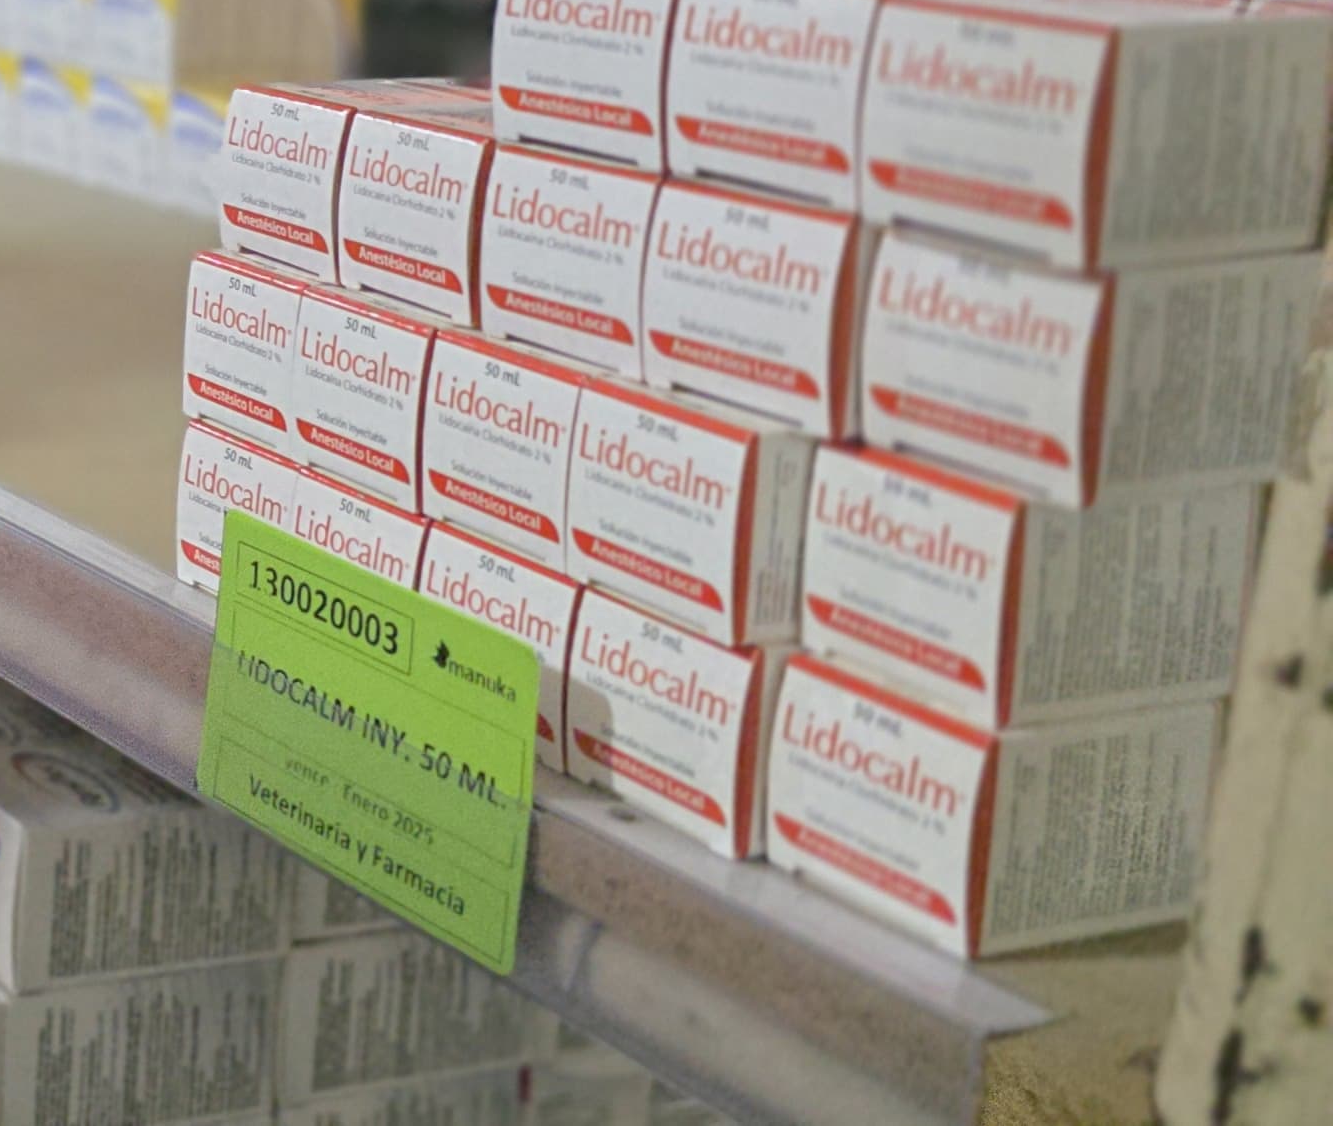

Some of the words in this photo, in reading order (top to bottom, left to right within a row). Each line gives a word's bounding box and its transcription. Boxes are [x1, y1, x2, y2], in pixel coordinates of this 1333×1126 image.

[683, 4, 853, 67] Lidocalm
[877, 41, 1077, 114] Lidocalm
[271, 103, 283, 116] 50
[284, 107, 300, 121] mL
[519, 92, 590, 120] Anestésico
[593, 104, 633, 125] Local
[228, 117, 328, 170] Lidocalm
[396, 131, 410, 145] 50
[411, 135, 429, 151] mL
[349, 146, 463, 204] Lidocalm
[550, 168, 567, 184] 50
[569, 174, 589, 190] mL
[237, 213, 287, 237] Anestésico
[288, 226, 314, 244] Local
[492, 183, 632, 248] Lidocalm
[359, 246, 415, 274] Anestésico
[417, 262, 446, 283] Local
[657, 220, 820, 295] Lidocalm
[229, 277, 241, 289] 50
[242, 282, 256, 297] mL
[878, 268, 1074, 357] Lidocalm
[191, 287, 287, 348] Lidocalm
[344, 317, 359, 331] 50
[360, 323, 377, 339] mL
[505, 292, 575, 323] Anestésico
[578, 311, 614, 336] Local
[301, 327, 410, 396] Lidocalm
[485, 361, 501, 379] 50
[502, 369, 521, 386] mL
[200, 382, 247, 411] Anestésico
[249, 399, 273, 421] Local
[434, 372, 559, 448] Lidocalm
[311, 428, 365, 459] Anestésico
[366, 448, 394, 472] Local
[638, 415, 655, 431] 50
[657, 423, 679, 442] mL
[224, 448, 237, 462] 50
[238, 453, 253, 470] mL
[579, 423, 727, 510] Lidocalm
[184, 455, 283, 525] Lidocalm
[339, 498, 354, 512] 50
[355, 505, 371, 522] mL
[445, 480, 508, 516] Anestésico
[509, 504, 542, 531] Local
[295, 505, 404, 582] Lidocalm
[815, 482, 991, 581] Lidocalm
[477, 555, 495, 572] 50
[496, 563, 516, 582] mL
[591, 540, 663, 582] Anestésico
[665, 569, 703, 598] Local
[249, 560, 400, 655] 130020003
[426, 560, 554, 648] Lidocalm
[642, 622, 660, 639] 50
[661, 633, 683, 654] mL
[448, 659, 516, 703] manuka
[581, 626, 729, 727] Lidocalm
[238, 650, 356, 731] LIDOCALM
[362, 713, 410, 762] INY.
[419, 743, 452, 779] 50
[458, 763, 506, 808] ML.
[782, 703, 961, 818] Lidocalm
[249, 775, 350, 851] Veterinaria
[356, 841, 368, 864] y
[372, 845, 465, 915] Farmacia
[394, 811, 433, 845] 2025
